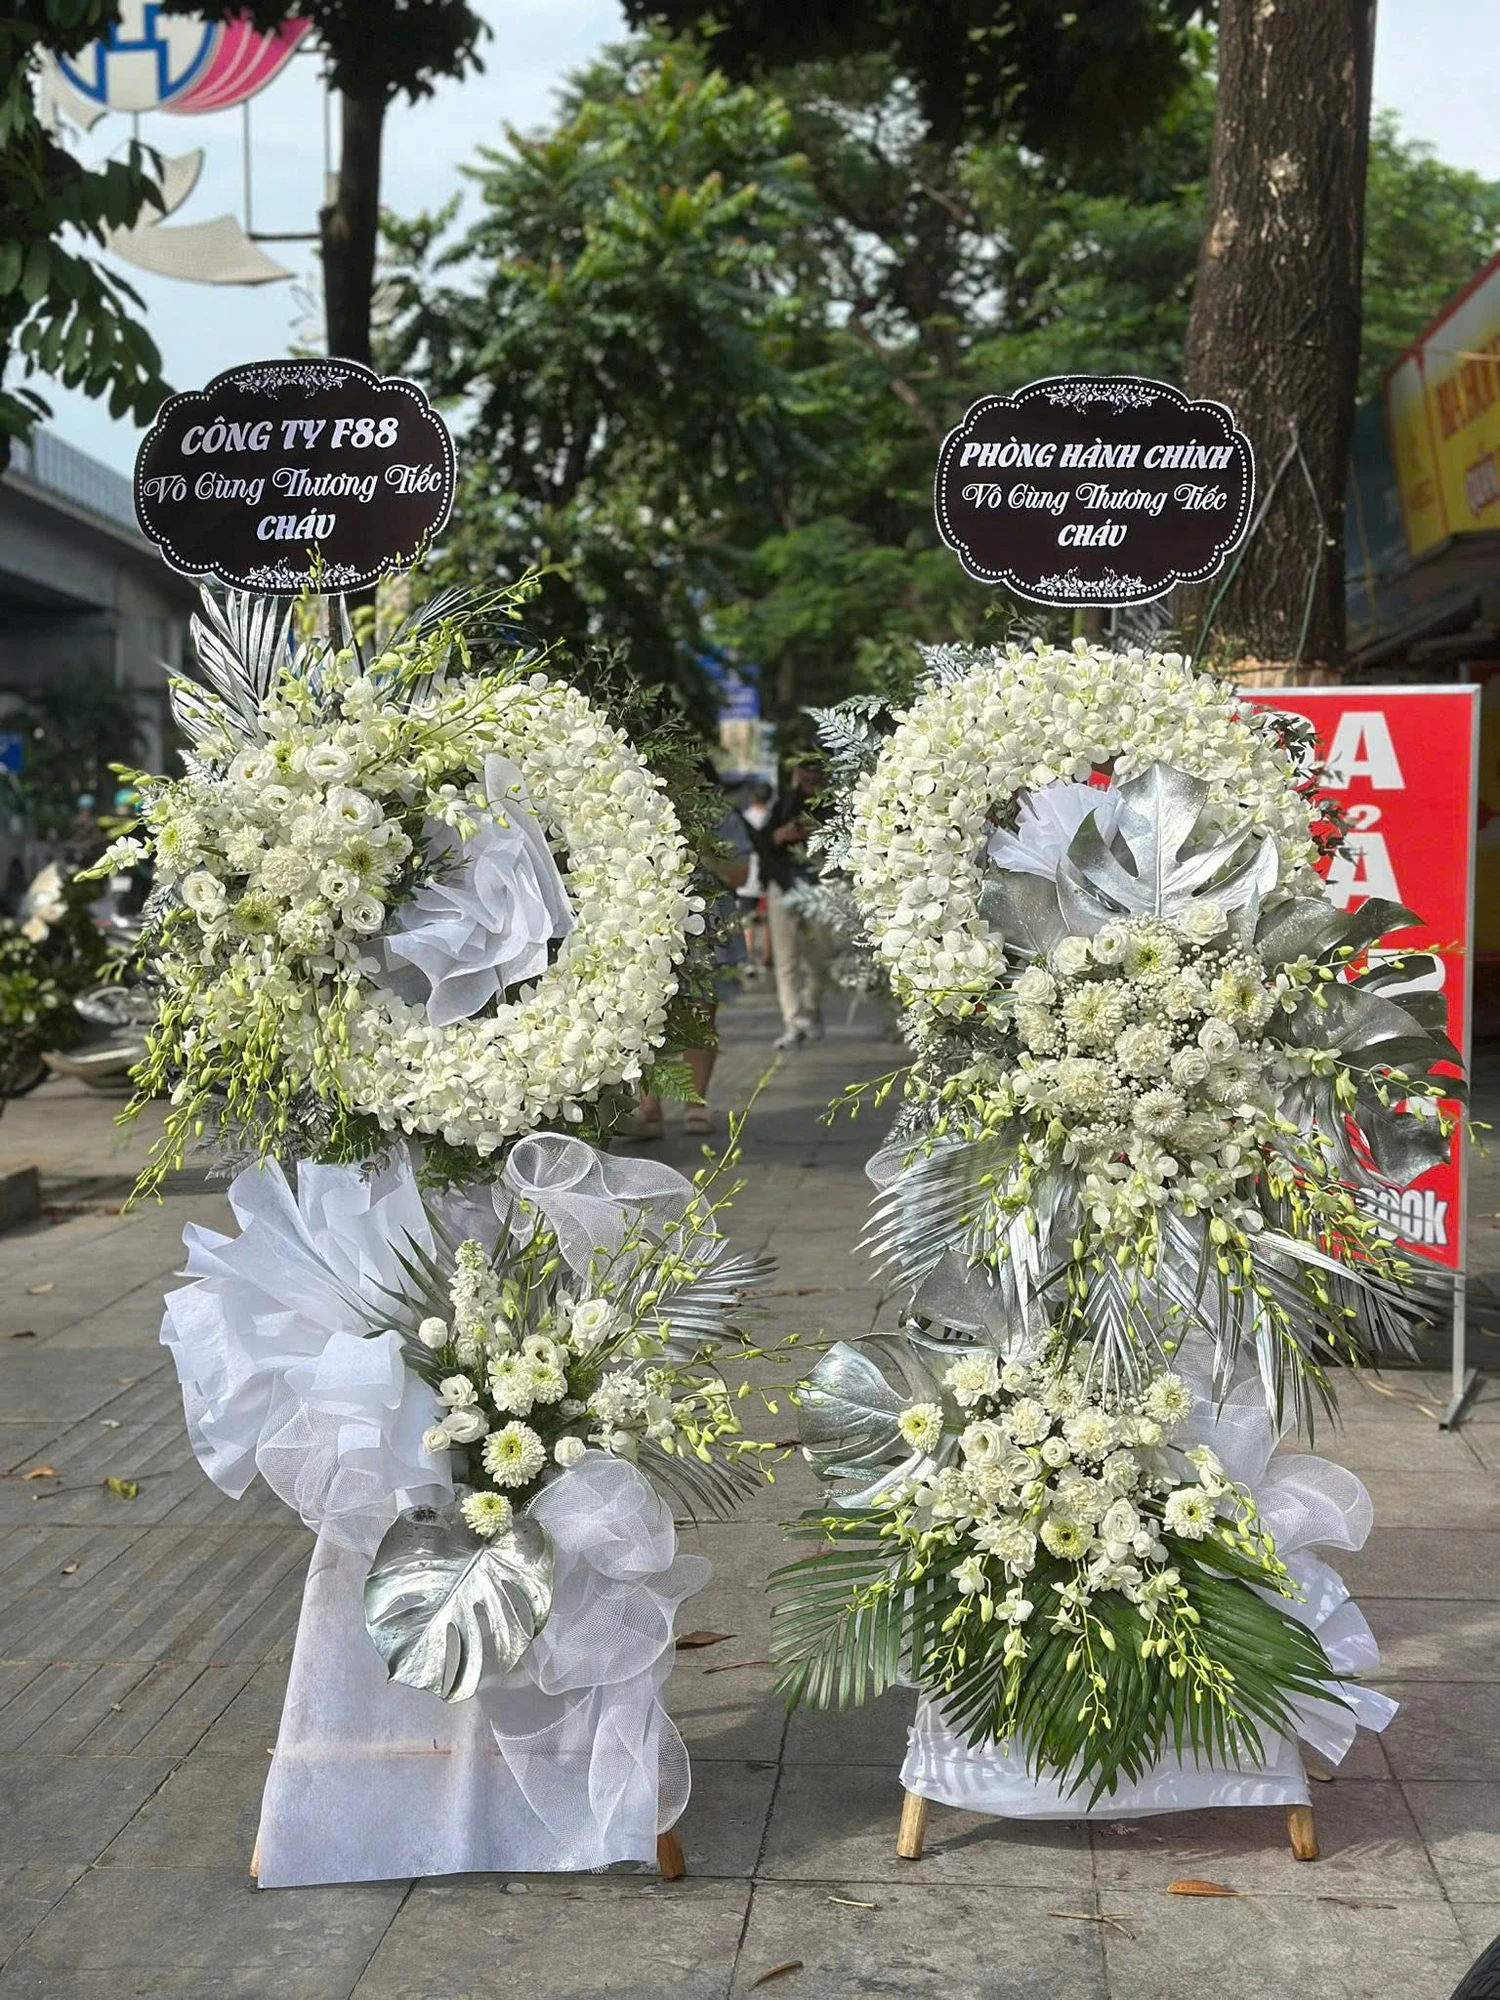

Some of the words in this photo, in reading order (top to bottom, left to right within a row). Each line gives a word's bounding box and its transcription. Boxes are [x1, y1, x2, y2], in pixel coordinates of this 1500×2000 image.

[181, 416, 273, 455] CÔNG
[281, 419, 326, 449] TY
[330, 417, 399, 449] F88
[959, 436, 1057, 467] PHÒNG
[1059, 438, 1141, 468] HÀNH
[1143, 438, 1235, 470] CHÍNH
[143, 475, 187, 503] Vô
[194, 472, 265, 505] Cùng
[272, 467, 378, 505] Thương
[384, 463, 442, 494] Tiếc
[961, 483, 1002, 509] Vô
[1007, 483, 1070, 516] Cùng
[1075, 482, 1168, 517] Thương
[1173, 483, 1228, 511] Tiếc
[256, 507, 336, 540] CHÁU
[1057, 518, 1128, 547] CHÁU
